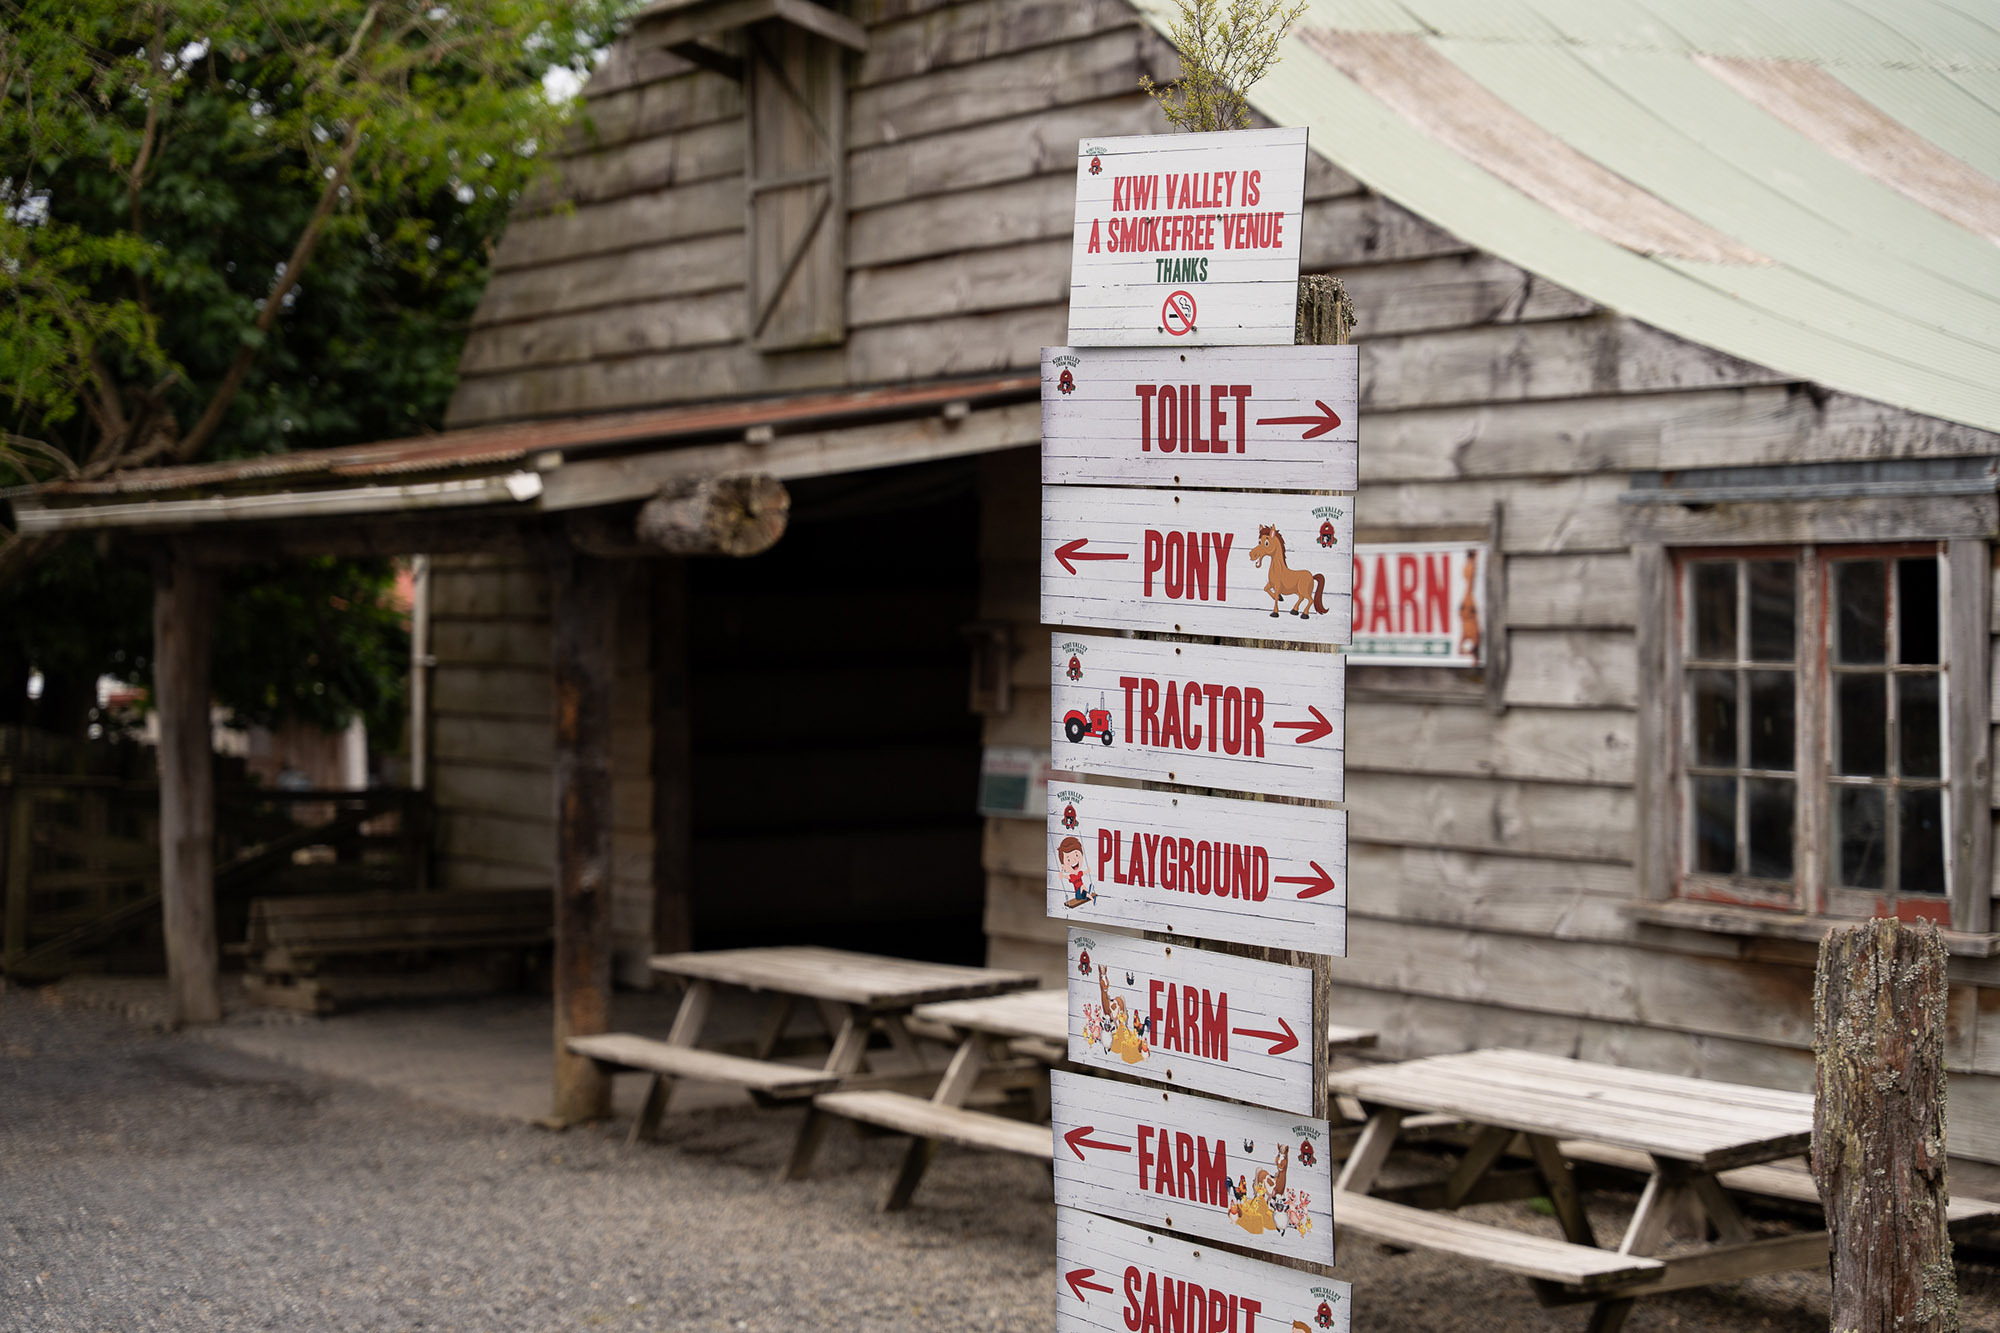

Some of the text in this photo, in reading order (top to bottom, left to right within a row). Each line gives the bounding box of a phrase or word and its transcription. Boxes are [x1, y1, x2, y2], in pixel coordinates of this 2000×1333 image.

[1112, 169, 1261, 212] KIWI VALLEY IS
[1087, 211, 1285, 254] A SMOKEFREE VENUE
[1156, 257, 1209, 283] THANKS
[1135, 384, 1252, 454] TOILET
[1143, 529, 1235, 602] PONY
[1119, 676, 1265, 758] TRACTOR
[1097, 828, 1269, 902] PLAYGROUND
[1149, 979, 1229, 1063] FARM
[1137, 1124, 1229, 1209] FARM
[1123, 1265, 1262, 1333] SANDPIT
